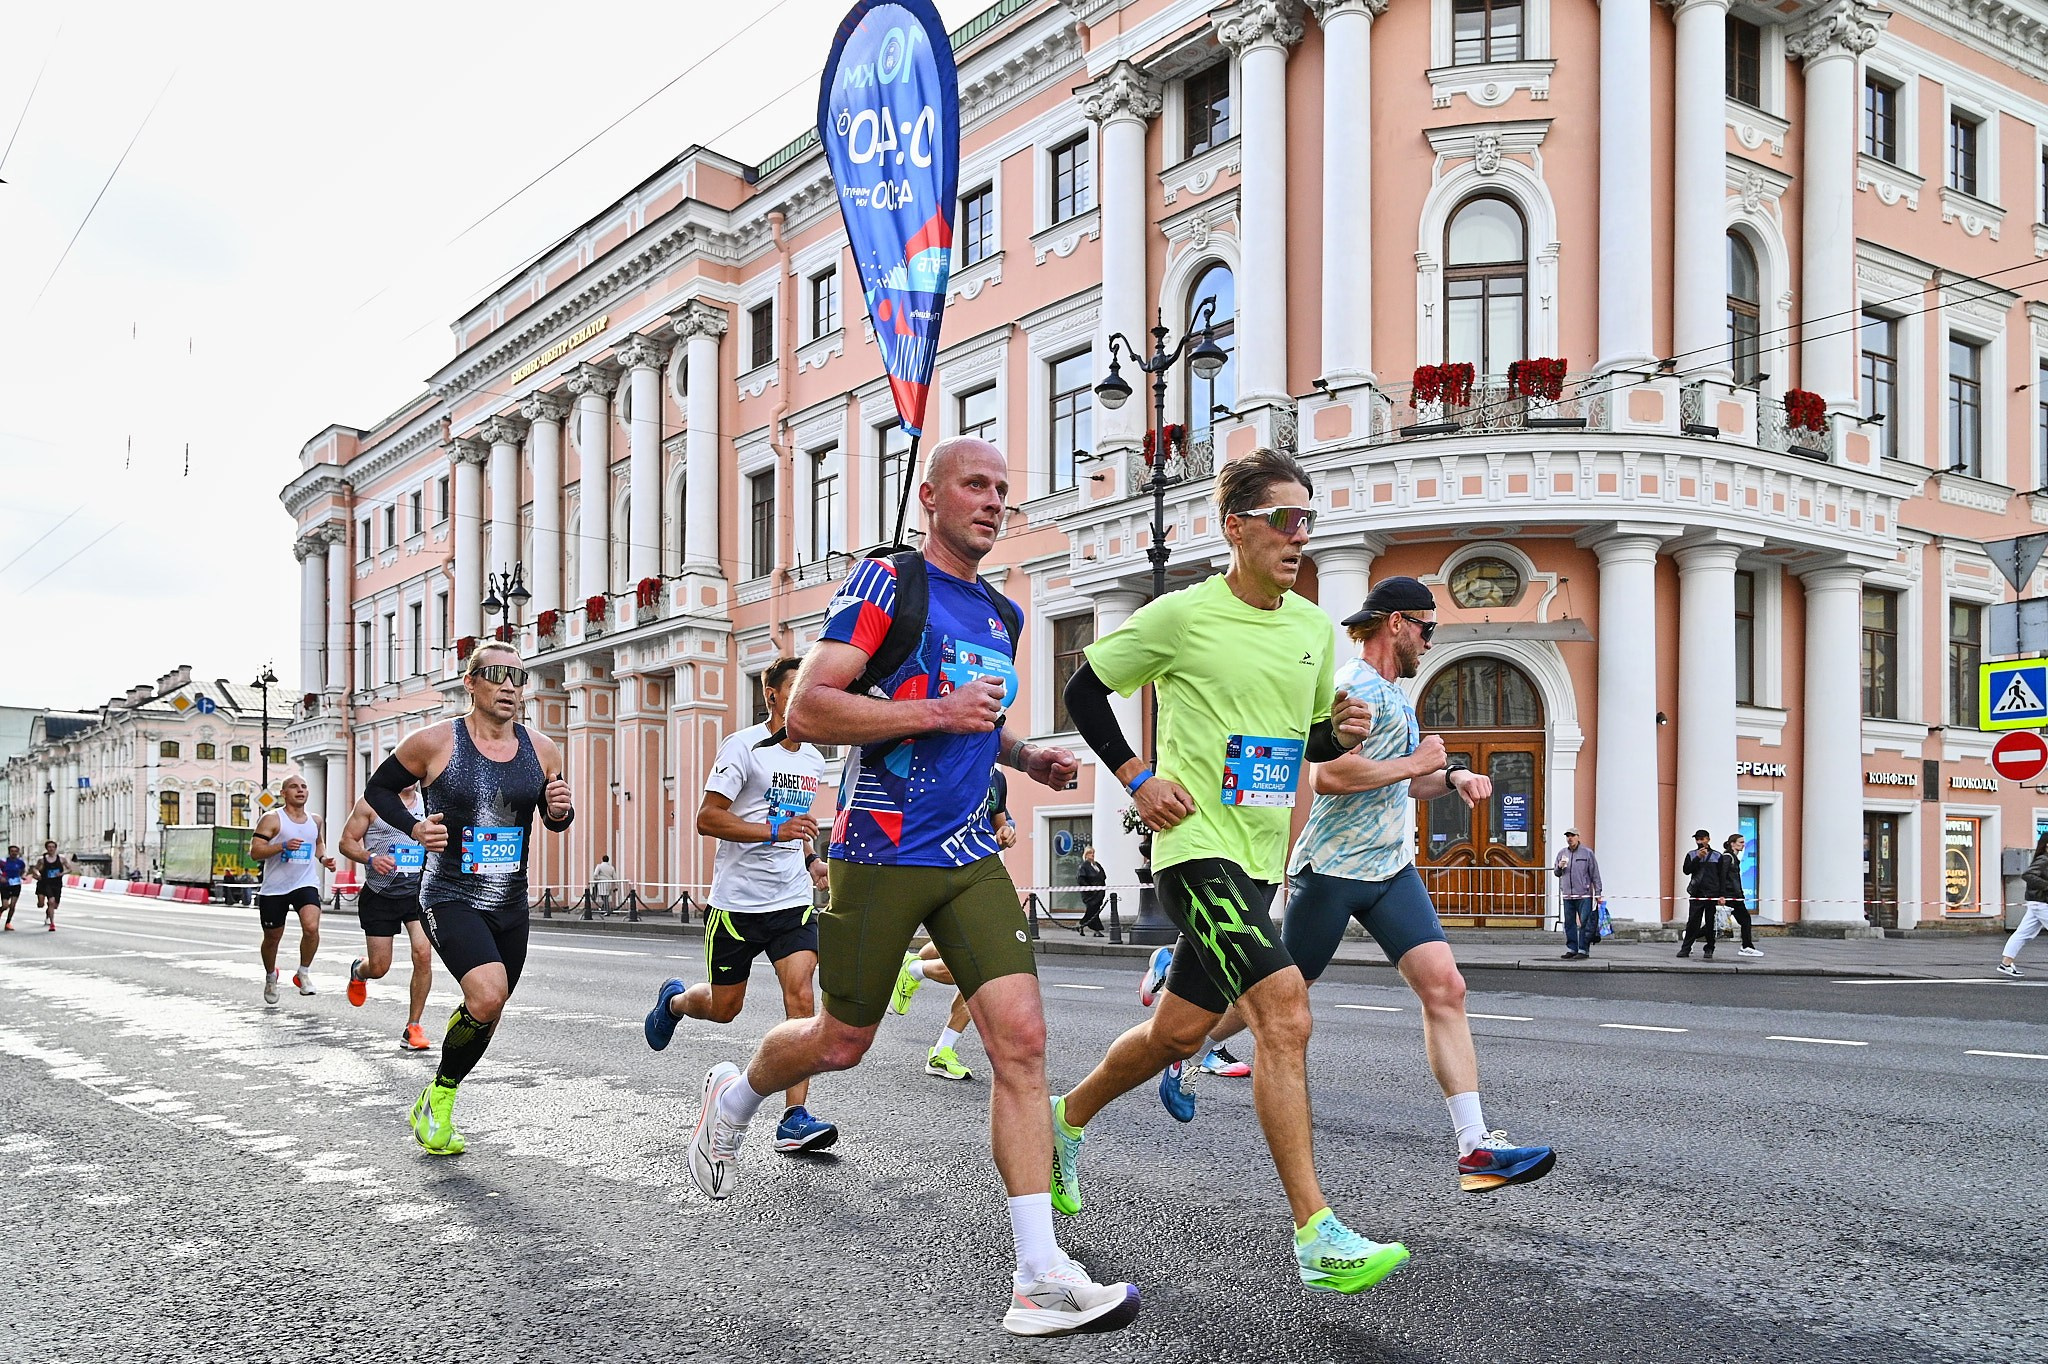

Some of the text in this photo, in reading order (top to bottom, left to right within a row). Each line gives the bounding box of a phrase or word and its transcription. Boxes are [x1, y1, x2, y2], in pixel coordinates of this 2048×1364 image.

[510, 314, 609, 386] БИЗНЕС-ЦЕНТР СЕНАТОР
[1252, 763, 1290, 782] 5140
[1753, 762, 1787, 777] БАНК
[1868, 771, 1999, 792] КОНФЕТЫ ШОКОЛАД
[764, 788, 785, 803] 45%
[481, 844, 516, 857] 5290
[400, 855, 420, 863] 8713
[1320, 1256, 1368, 1270] BROOKS
